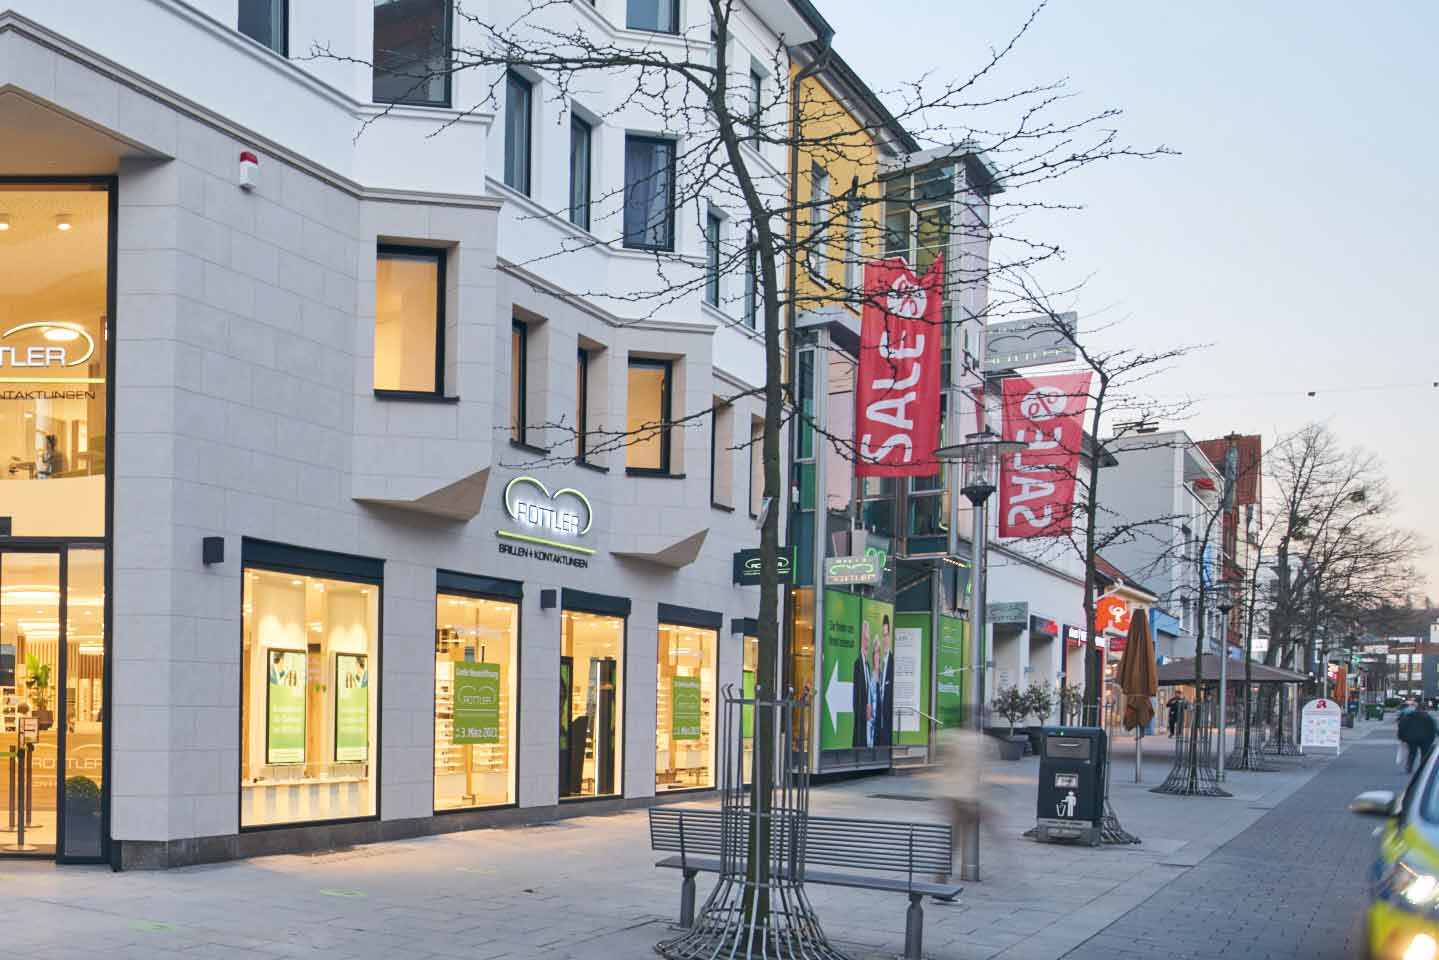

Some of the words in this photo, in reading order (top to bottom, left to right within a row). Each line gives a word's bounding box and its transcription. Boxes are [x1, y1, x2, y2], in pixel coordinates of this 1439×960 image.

[860, 331, 925, 463] SALE
[498, 543, 529, 558] BRILLEN
[534, 551, 589, 569] KONTAKTLINSEN
